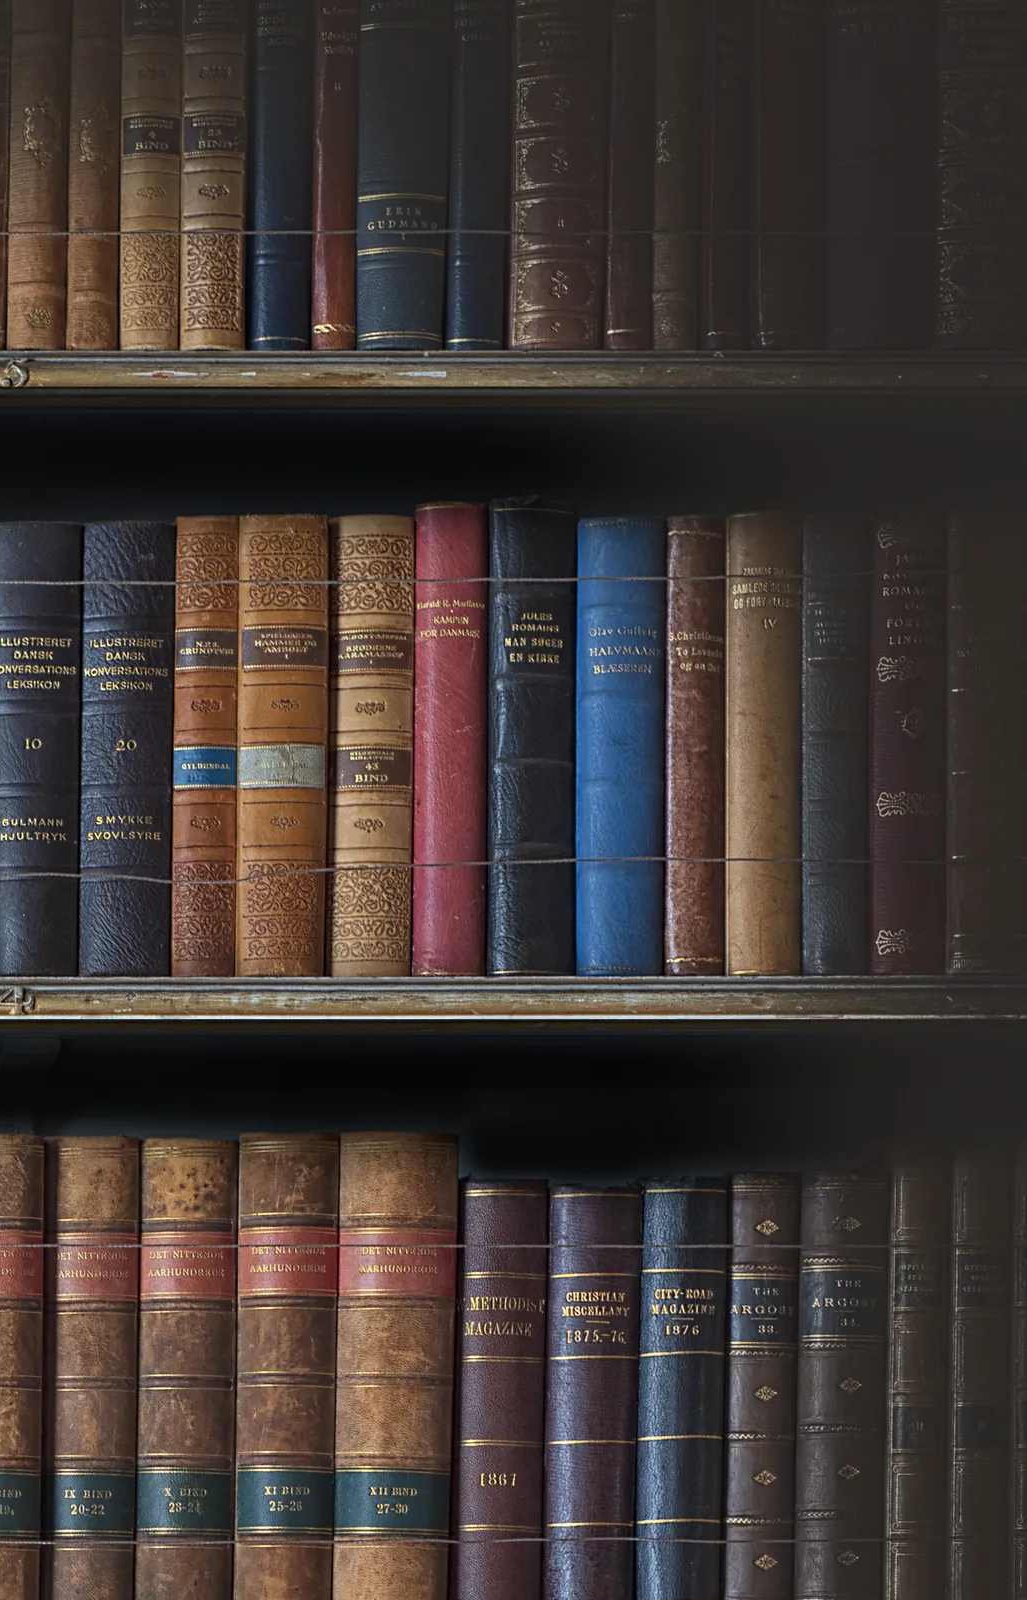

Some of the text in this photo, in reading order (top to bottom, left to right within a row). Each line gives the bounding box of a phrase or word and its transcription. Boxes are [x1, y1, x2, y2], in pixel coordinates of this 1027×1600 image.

[135, 141, 168, 151] BIND
[386, 206, 422, 215] ERIK
[434, 616, 469, 625] KAMPEN
[520, 612, 552, 621] JULES
[512, 623, 558, 632] ROMAINS
[589, 627, 614, 637] Olav
[420, 629, 479, 638] FOR DANMARK
[90, 638, 164, 648] ILLUSTRERET
[504, 638, 562, 648] MAN SØGER
[14, 651, 53, 659] DANSK
[106, 652, 145, 661] DANSK
[510, 653, 559, 663] EN KIRKE
[85, 667, 168, 677] KONVERSATIONS
[594, 665, 651, 674] BLÆSEREN
[7, 681, 60, 689] LEKSIKON
[100, 682, 153, 691] LEKSIKON
[25, 739, 41, 749] 10
[116, 740, 137, 751] 20
[355, 774, 387, 782] BIND
[2, 818, 63, 826] GULMANN
[96, 816, 152, 824] SMYKKE
[1, 832, 66, 841] HJULTRYK
[88, 832, 160, 841] SVOVLSYRE
[149, 1250, 223, 1259] DET NITTENDE
[835, 1280, 862, 1288] THE
[654, 1289, 713, 1299] CITY-ROAD
[753, 1287, 779, 1297] THE
[566, 1292, 624, 1302] CHRISTIAN
[812, 1297, 877, 1308] ARGOSY
[562, 1306, 629, 1316] MISCELLANY
[652, 1305, 715, 1315] MAGAZINE
[465, 1322, 531, 1336] MAGAZINE
[665, 1326, 699, 1335] 1876
[64, 1490, 112, 1498] IX BIND
[179, 1488, 206, 1496] BIND
[265, 1487, 309, 1495] XI BIND
[392, 1487, 417, 1496] BIND
[71, 1504, 105, 1514] 20-22
[270, 1501, 302, 1511] 25-26
[376, 1504, 408, 1514] 27-30
